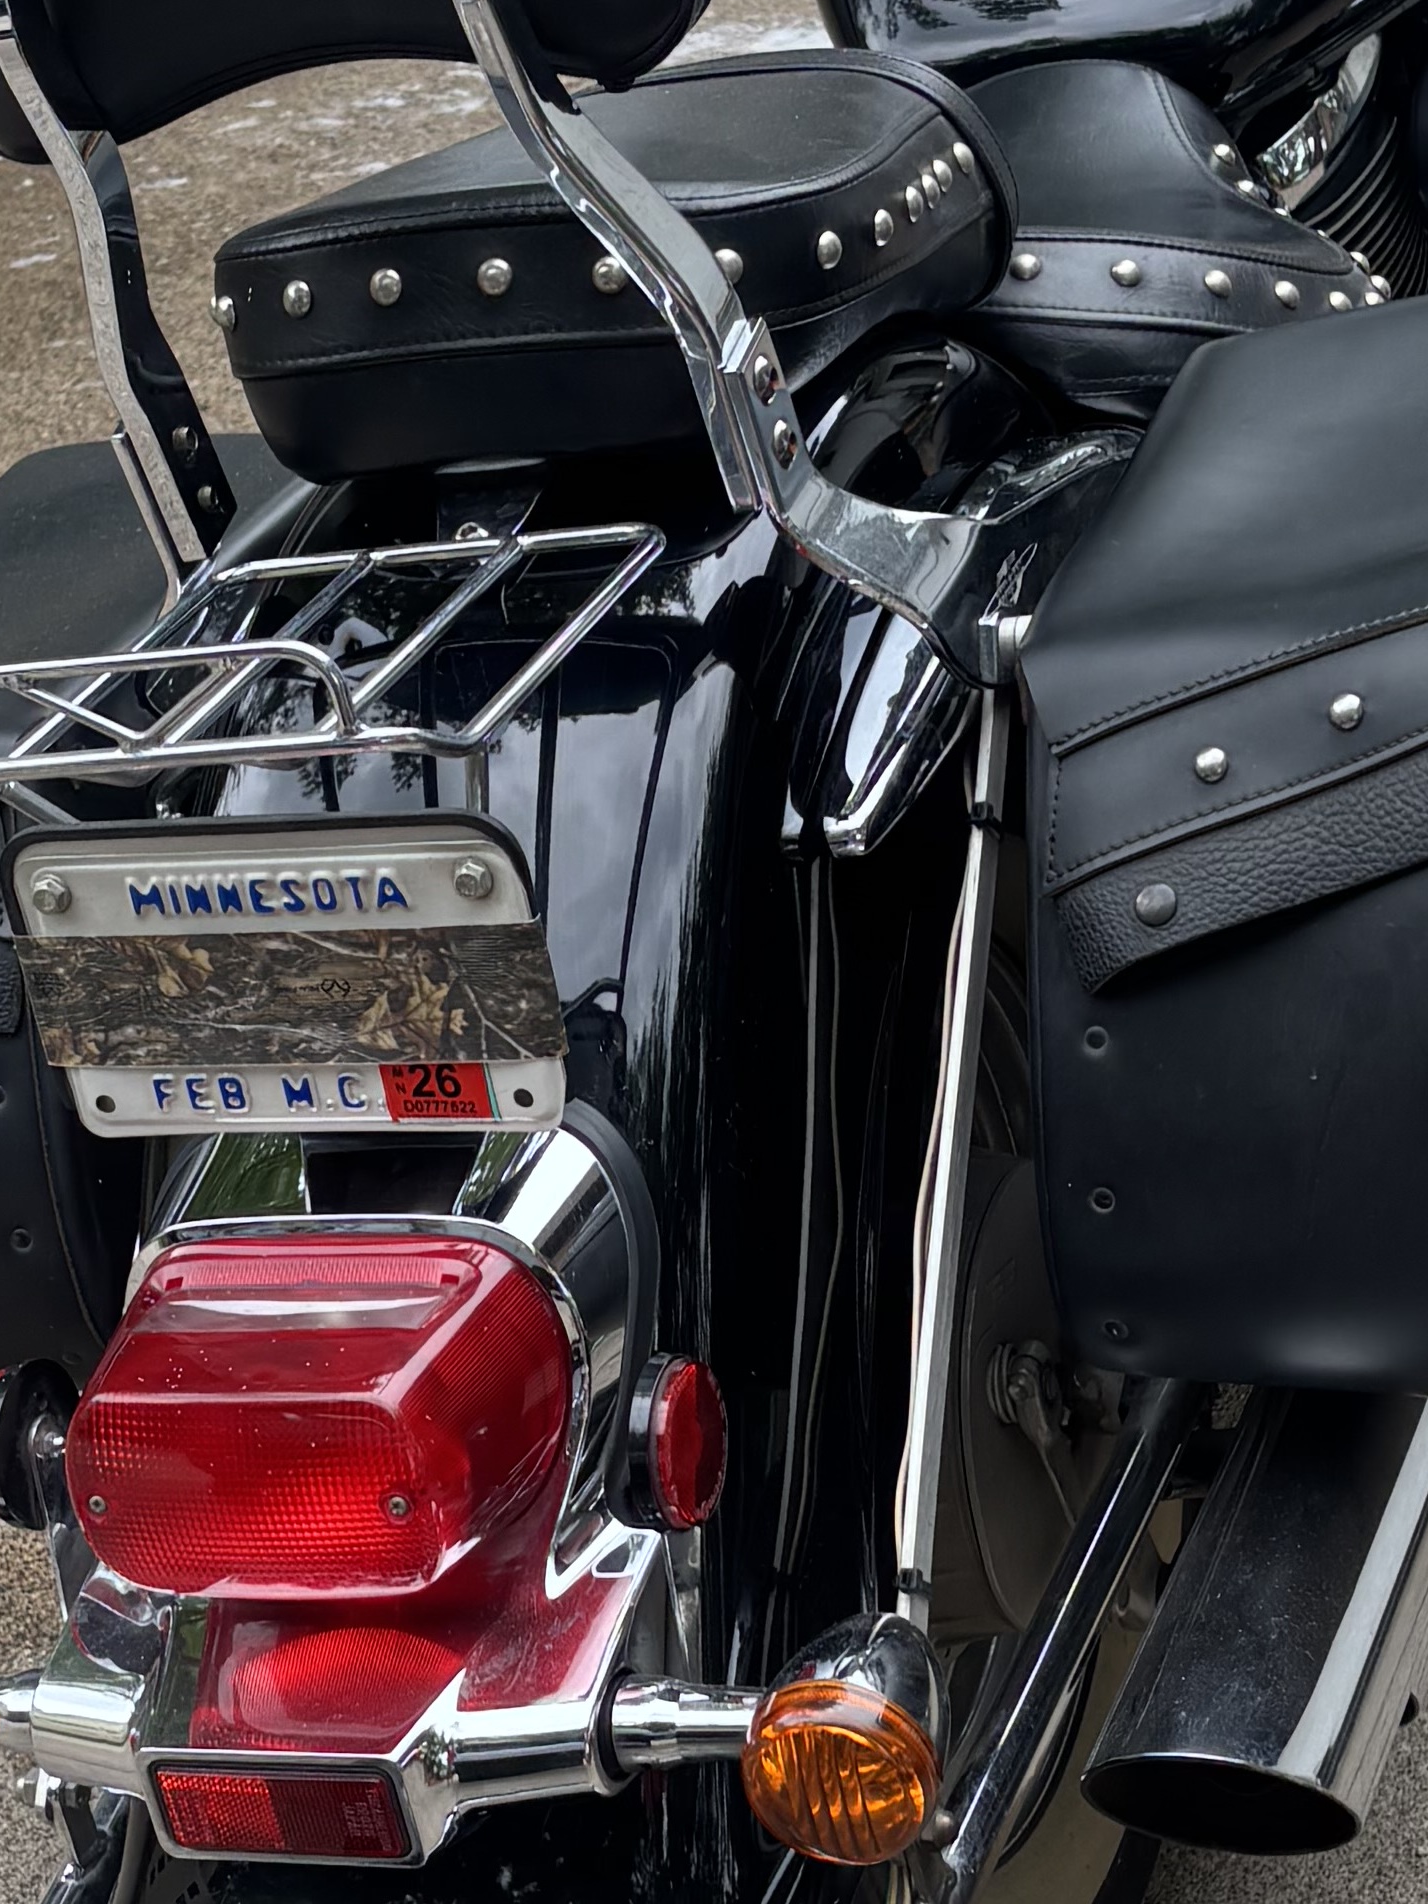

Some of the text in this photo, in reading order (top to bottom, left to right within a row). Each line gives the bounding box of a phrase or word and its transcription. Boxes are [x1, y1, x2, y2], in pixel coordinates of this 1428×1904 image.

[127, 873, 410, 918] MINNESOTA
[152, 1073, 248, 1113] FEB
[408, 1063, 462, 1099] 26
